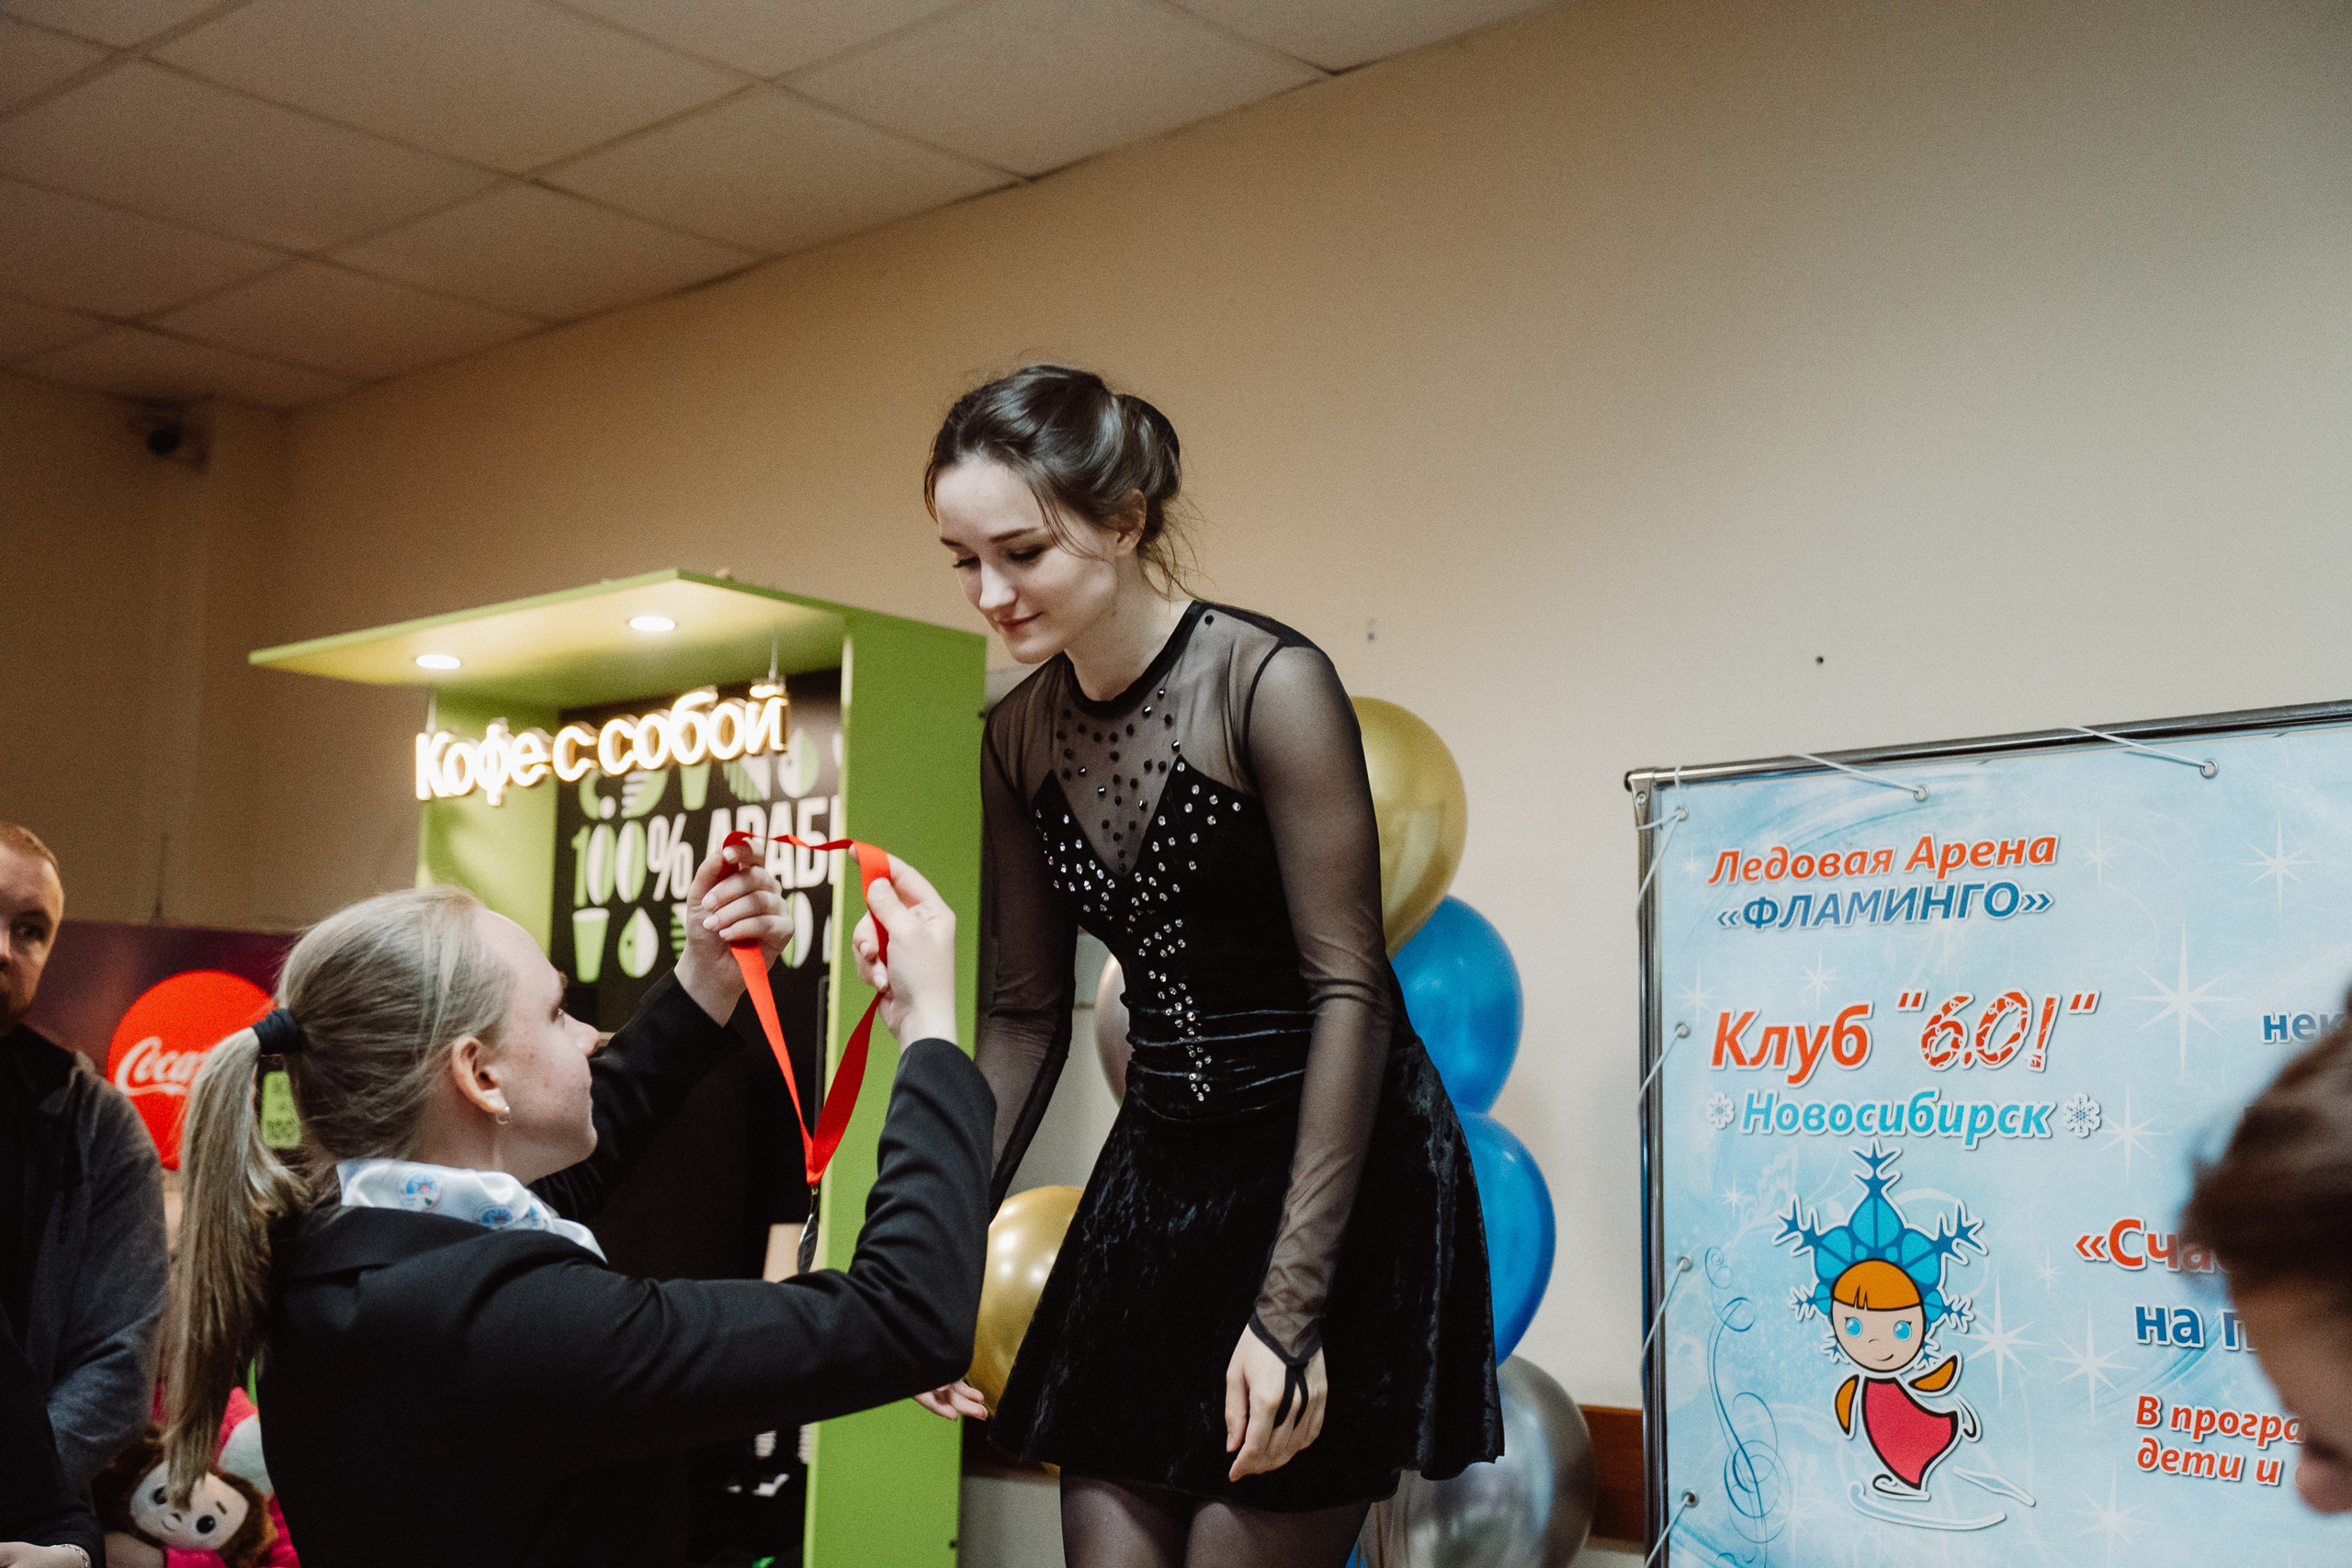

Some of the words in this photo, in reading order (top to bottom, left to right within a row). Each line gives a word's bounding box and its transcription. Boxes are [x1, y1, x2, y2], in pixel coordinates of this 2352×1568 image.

[416, 717, 551, 806] Кофе
[598, 682, 786, 774] собой
[571, 815, 694, 908] 100%
[706, 795, 841, 888] АРАБ
[1709, 846, 1893, 885] Ледовая
[1905, 835, 2057, 879] Арена
[1717, 882, 2051, 929] «ФЛАМИНГО»
[1712, 1004, 1871, 1084] Клуб
[1744, 1090, 2052, 1146] Новосибирск
[2075, 1218, 2216, 1269] «Сча
[2134, 1305, 2202, 1345] на
[2136, 1395, 2158, 1425] В
[2137, 1437, 2241, 1479] дети
[2256, 1459, 2279, 1483] и
